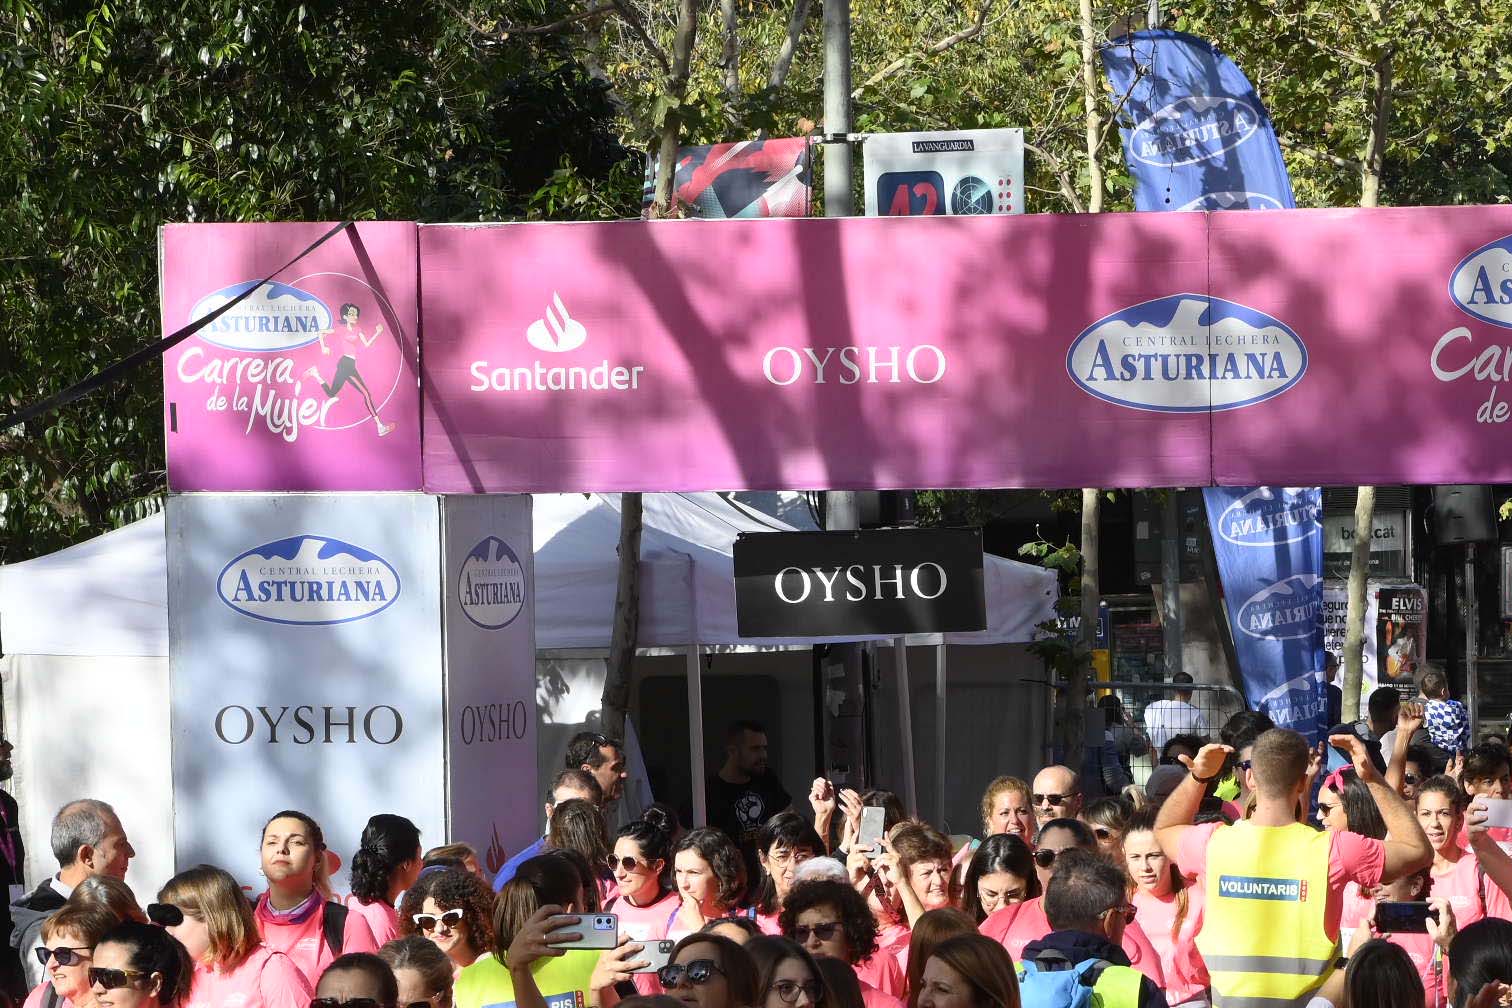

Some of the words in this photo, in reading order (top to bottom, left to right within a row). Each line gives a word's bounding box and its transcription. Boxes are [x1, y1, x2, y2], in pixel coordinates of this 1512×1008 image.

[1085, 337, 1290, 383] ASTURIANA
[1121, 334, 1198, 348] CENTRAL
[1206, 333, 1281, 347] LECHERA
[177, 346, 295, 385] Carrera
[469, 361, 645, 393] Santander
[762, 344, 947, 386] OYSHO
[206, 386, 228, 411] de
[232, 385, 249, 411] la
[246, 381, 340, 443] Mujer
[1476, 384, 1512, 425] de
[231, 568, 387, 603] ASTURIANA
[258, 566, 318, 577] CENTRAL
[322, 566, 382, 576] LECHERA
[463, 568, 522, 608] ASTURIANA
[774, 561, 948, 604] OYSHO
[1391, 598, 1423, 611] ELVIS
[214, 704, 404, 745] OYSHO
[460, 699, 528, 746] OYSHO
[1220, 880, 1298, 896] VOLUNTARIS
